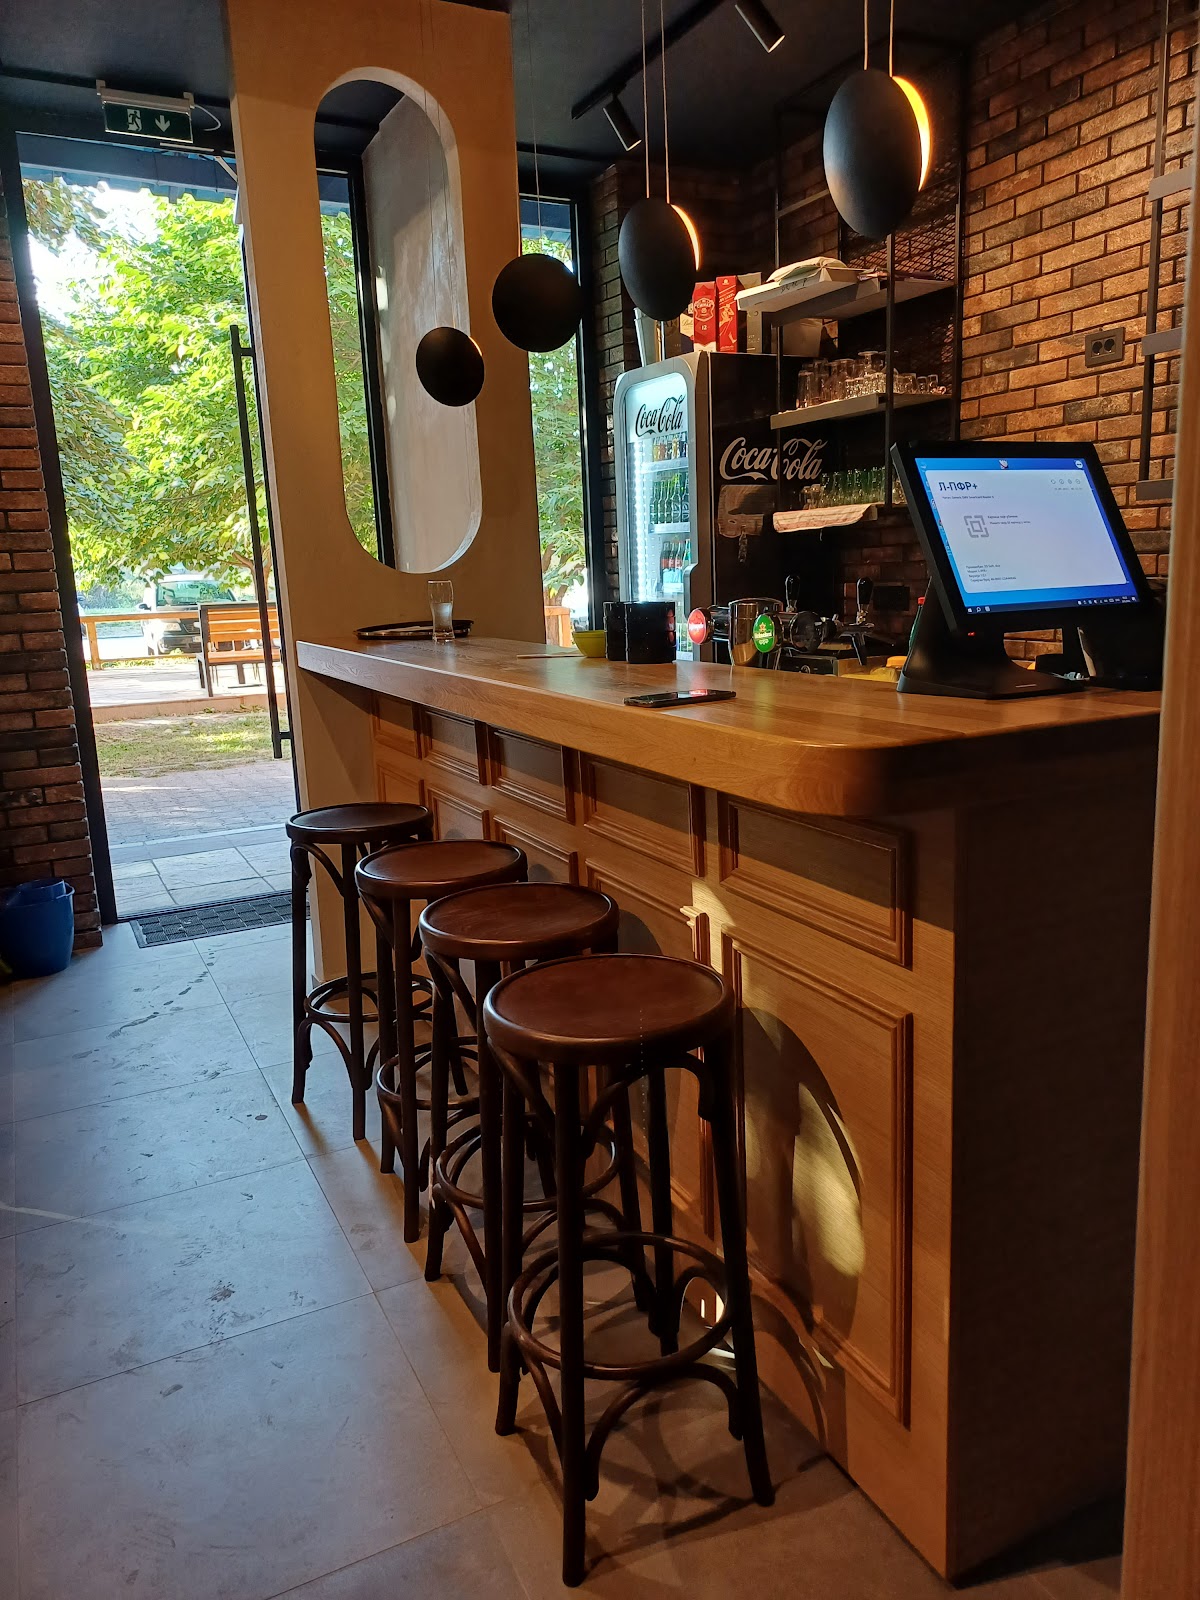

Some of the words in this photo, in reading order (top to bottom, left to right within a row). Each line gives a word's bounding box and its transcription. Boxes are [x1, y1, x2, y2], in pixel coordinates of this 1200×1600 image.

[635, 394, 686, 438] Coca-Cola
[719, 436, 828, 481] Coca-Cola
[938, 481, 978, 491] Л-ПФР+
